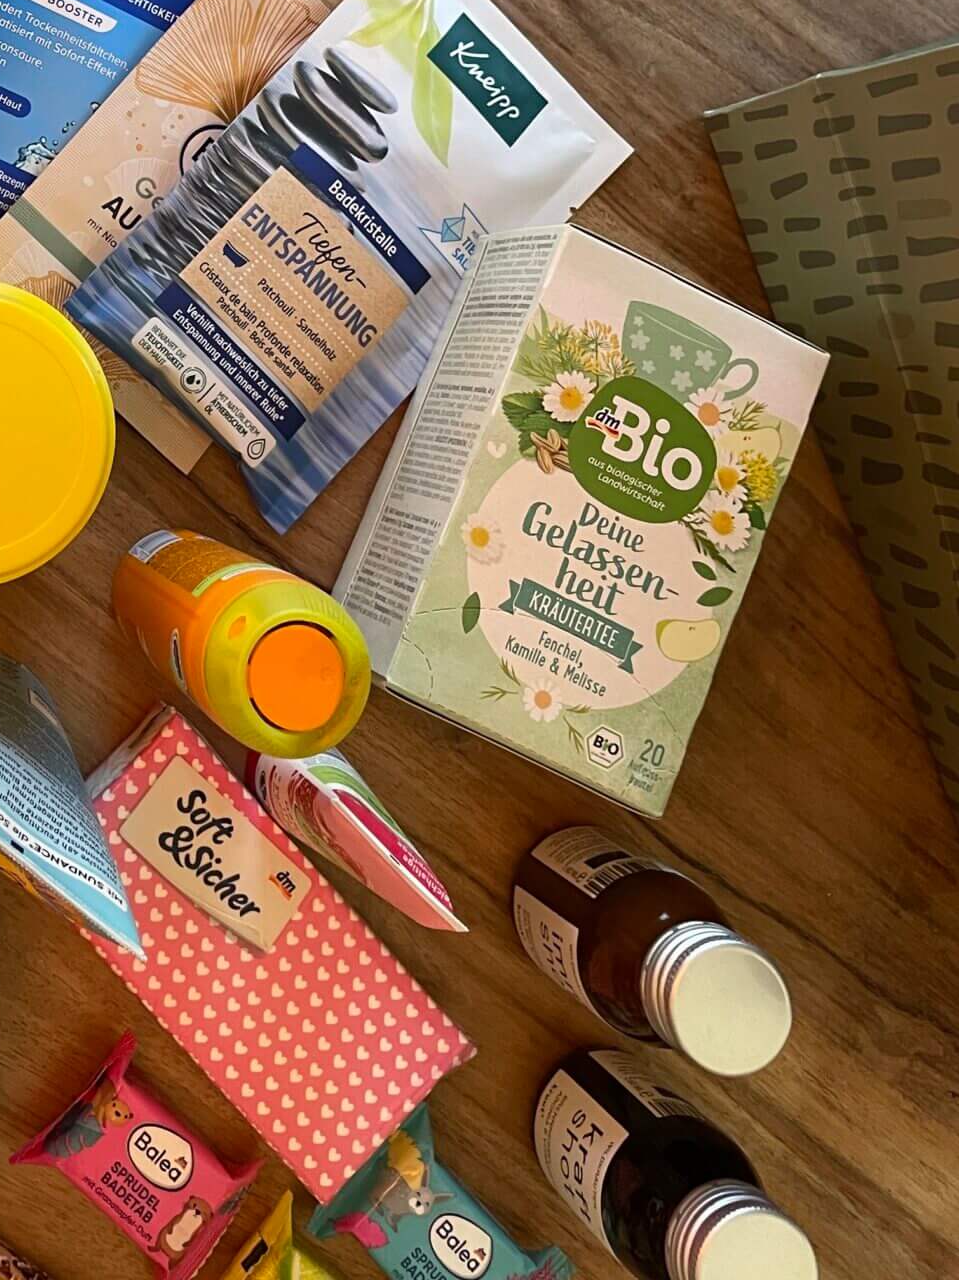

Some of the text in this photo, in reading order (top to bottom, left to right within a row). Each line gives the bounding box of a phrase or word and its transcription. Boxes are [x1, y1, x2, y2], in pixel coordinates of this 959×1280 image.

[53, 42, 118, 80] Sofort-Effekt
[450, 41, 520, 119] Kneipp
[328, 179, 398, 257] Badekristalle
[240, 203, 377, 348] ENTSPANNUNG
[295, 212, 366, 289] Tiefen-
[200, 262, 325, 394] Cristaux bain Profonde relaxation
[217, 297, 249, 330] Patchouli
[249, 331, 265, 349] Bois
[258, 278, 336, 361] Patchouli Sandelholz
[145, 332, 184, 370] FEUCHTIGKEIT
[173, 309, 261, 401] Entspannung und innerer
[186, 304, 288, 411] Verhilft nachweislich tiefer
[596, 408, 620, 429] dm
[602, 395, 702, 491] Bio
[588, 457, 663, 497] aus biologischer
[598, 473, 666, 512] Landwirtschaft
[522, 501, 679, 601] Gelassen-
[578, 503, 645, 553] Deine
[556, 558, 622, 617] heit
[528, 590, 620, 649] KRÄUTERTEE
[505, 635, 607, 698] Kamille & Melisse
[539, 631, 583, 668] Fenchel,
[640, 739, 665, 766] 20
[12, 826, 29, 841] die
[176, 789, 234, 844] Soft
[185, 838, 261, 917] Sicher
[276, 871, 296, 894] dm
[134, 1131, 182, 1183] Balea
[100, 1172, 153, 1224] BADETAB
[111, 1161, 161, 1213] SPRUDEL
[436, 1219, 480, 1273] Balea
